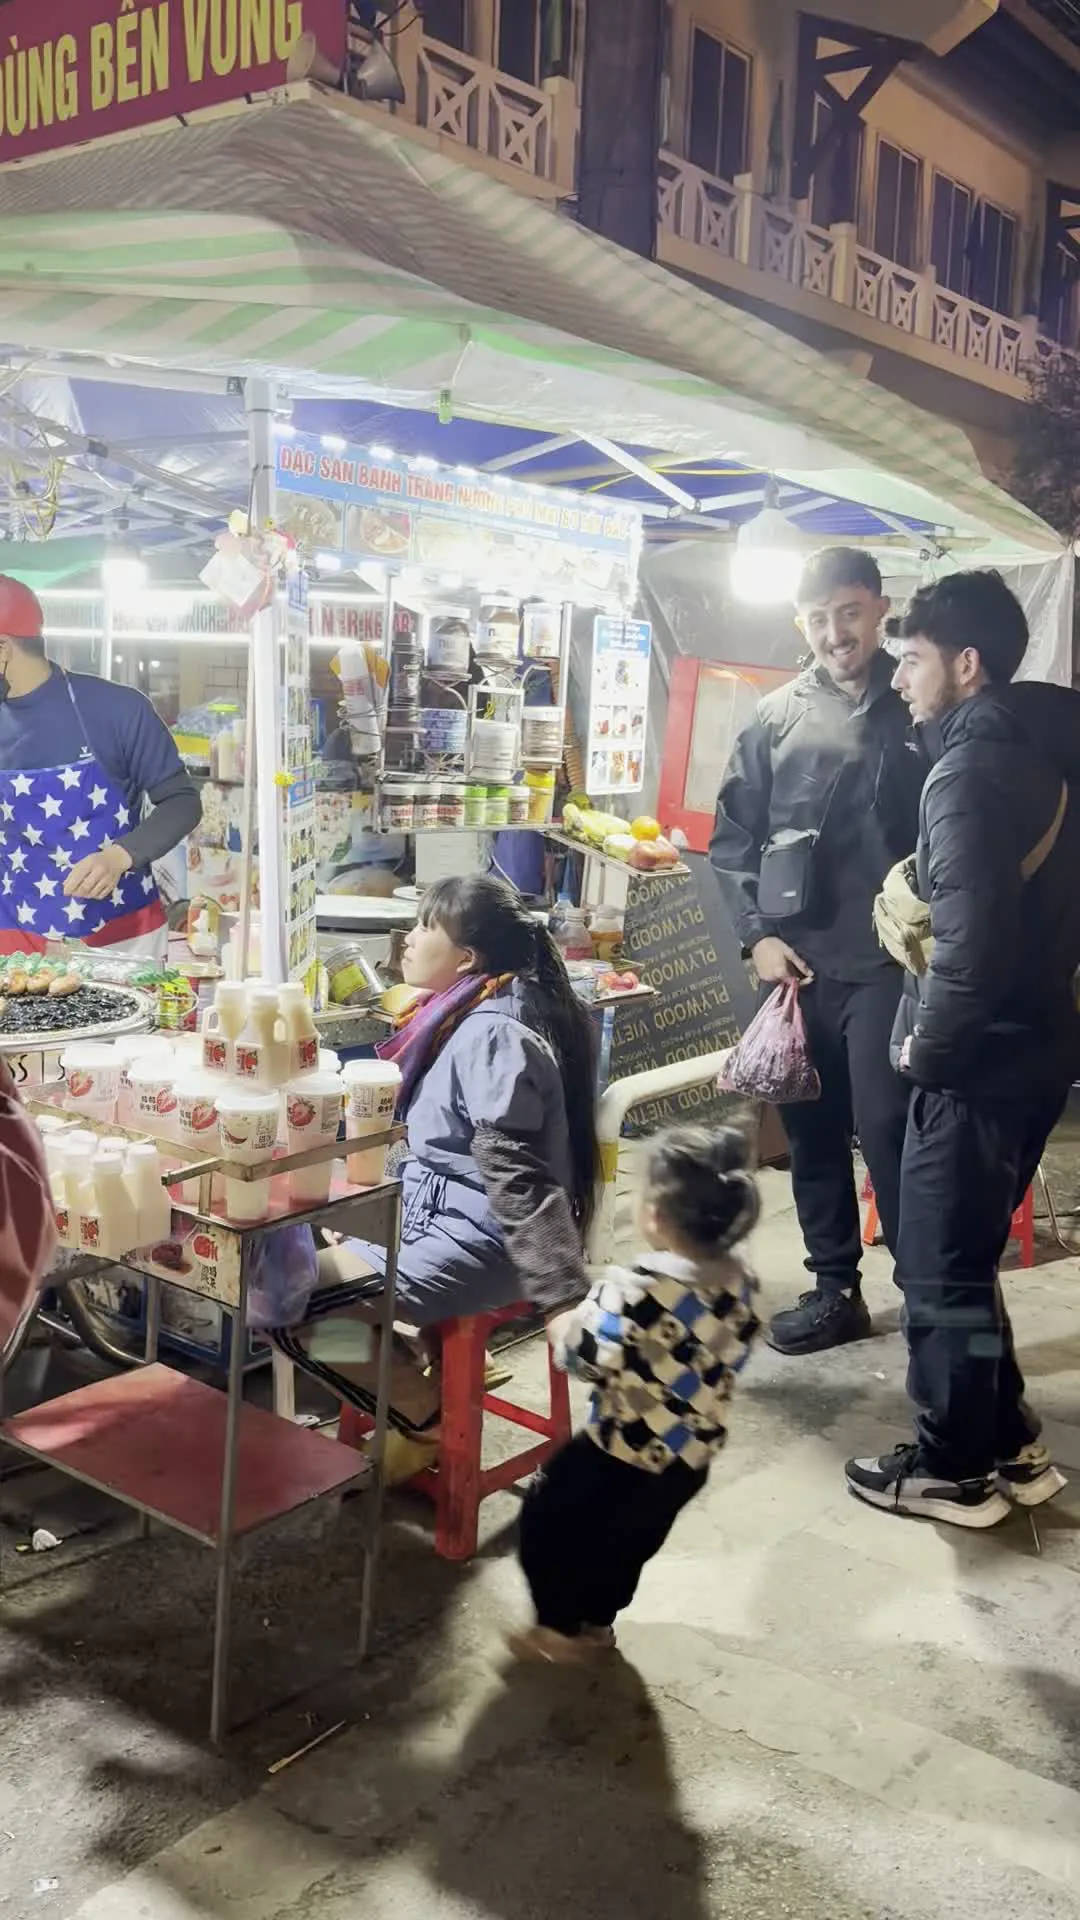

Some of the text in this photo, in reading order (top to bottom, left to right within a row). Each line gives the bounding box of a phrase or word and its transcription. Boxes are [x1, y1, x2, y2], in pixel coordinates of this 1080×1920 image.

[0, 34, 79, 136] ÙNG
[630, 904, 705, 951] PLYWOOD
[641, 943, 718, 988] PLYWOOD
[654, 984, 731, 1030] PLYWOOD
